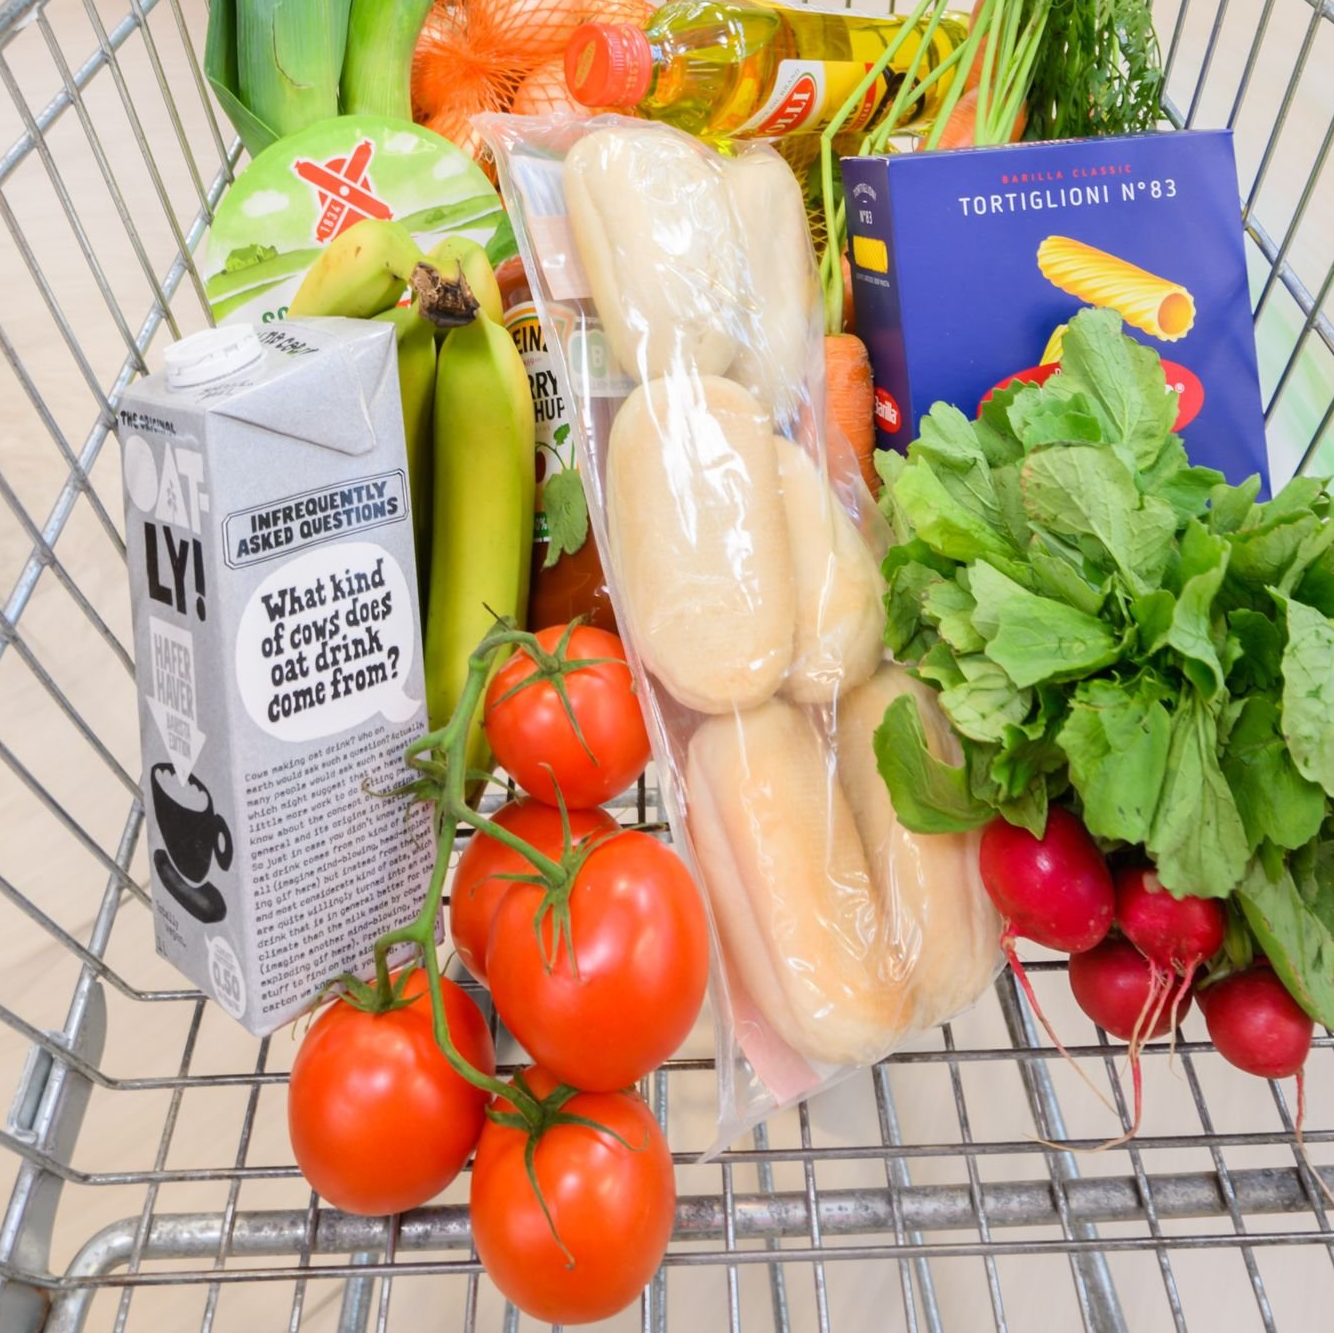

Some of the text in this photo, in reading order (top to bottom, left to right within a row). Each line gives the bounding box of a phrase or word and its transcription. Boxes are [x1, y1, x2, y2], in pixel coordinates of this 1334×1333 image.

[764, 92, 811, 134] OLLI
[959, 179, 1177, 216] TORTIGLIONI N°83
[1002, 164, 1132, 185] BARILLA CLASSIC
[320, 205, 342, 233] 1834
[512, 325, 548, 355] EIN
[527, 369, 559, 400] RRY
[120, 410, 139, 430] THE
[235, 496, 398, 559] ASKED QUESTIONS
[250, 481, 389, 534] INFREQUENTLY
[143, 522, 206, 622] LY!
[261, 558, 385, 623] What kind
[261, 591, 392, 659] of cows does
[154, 633, 193, 685] HAFER
[267, 645, 400, 723] come from?
[271, 625, 383, 687] oat drink
[156, 669, 195, 721] HAVER
[244, 769, 268, 782] Cows
[271, 756, 305, 774] making
[308, 748, 322, 760] oat
[325, 735, 355, 754] drink?
[374, 726, 385, 735] on
[246, 779, 273, 794] earth
[276, 769, 302, 785] would
[304, 762, 318, 775] ask
[321, 754, 340, 768] such
[246, 795, 270, 807] many
[274, 782, 306, 801] people
[309, 769, 335, 786] would
[339, 761, 353, 774] ask
[356, 752, 375, 767] such
[247, 803, 277, 820] which
[280, 793, 307, 810] might
[311, 777, 345, 798] suggest
[349, 768, 368, 783] that
[371, 765, 380, 774] we
[383, 755, 402, 768] have
[249, 833, 273, 846] know
[277, 820, 304, 837] about
[308, 814, 323, 825] the
[326, 796, 361, 818] concept
[392, 772, 415, 789] drink
[249, 817, 282, 833] little
[286, 807, 307, 821] more
[311, 796, 331, 811] work
[335, 792, 344, 801] to
[347, 787, 358, 796] do
[251, 803, 379, 861] general and its origins in
[251, 809, 395, 872] So just in case you didn't know
[252, 871, 270, 884] oat
[272, 860, 300, 878] drink
[303, 850, 329, 866] comes
[332, 840, 352, 854] from
[355, 834, 365, 844] no
[368, 823, 387, 838] kind
[390, 817, 399, 828] of
[402, 809, 419, 822] cws
[253, 842, 378, 897] all (imagine mind-blowing,
[254, 899, 272, 910] ing
[276, 889, 291, 905] gif
[295, 878, 320, 895] here)
[323, 870, 338, 884] but
[342, 853, 376, 875] instead
[379, 845, 397, 858] from
[415, 826, 430, 841] best
[255, 909, 273, 923] and
[275, 901, 296, 916] most
[300, 878, 353, 907] considerate
[356, 866, 375, 881] kind
[377, 861, 386, 872] of
[389, 851, 410, 866] oats,
[257, 851, 431, 936] are quite willingly turned into an oat
[257, 864, 434, 949] drink that is in general better for the
[258, 883, 421, 961] climate than the milk made by cows
[259, 951, 305, 976] (imagine
[308, 934, 344, 955] another
[347, 902, 410, 937] mind-blowing,
[313, 952, 328, 968] gif
[331, 939, 359, 958] here).
[362, 924, 391, 942] Pretty
[261, 953, 356, 1000] stuff to find on the
[262, 993, 297, 1013] carton
[301, 988, 311, 997] we
